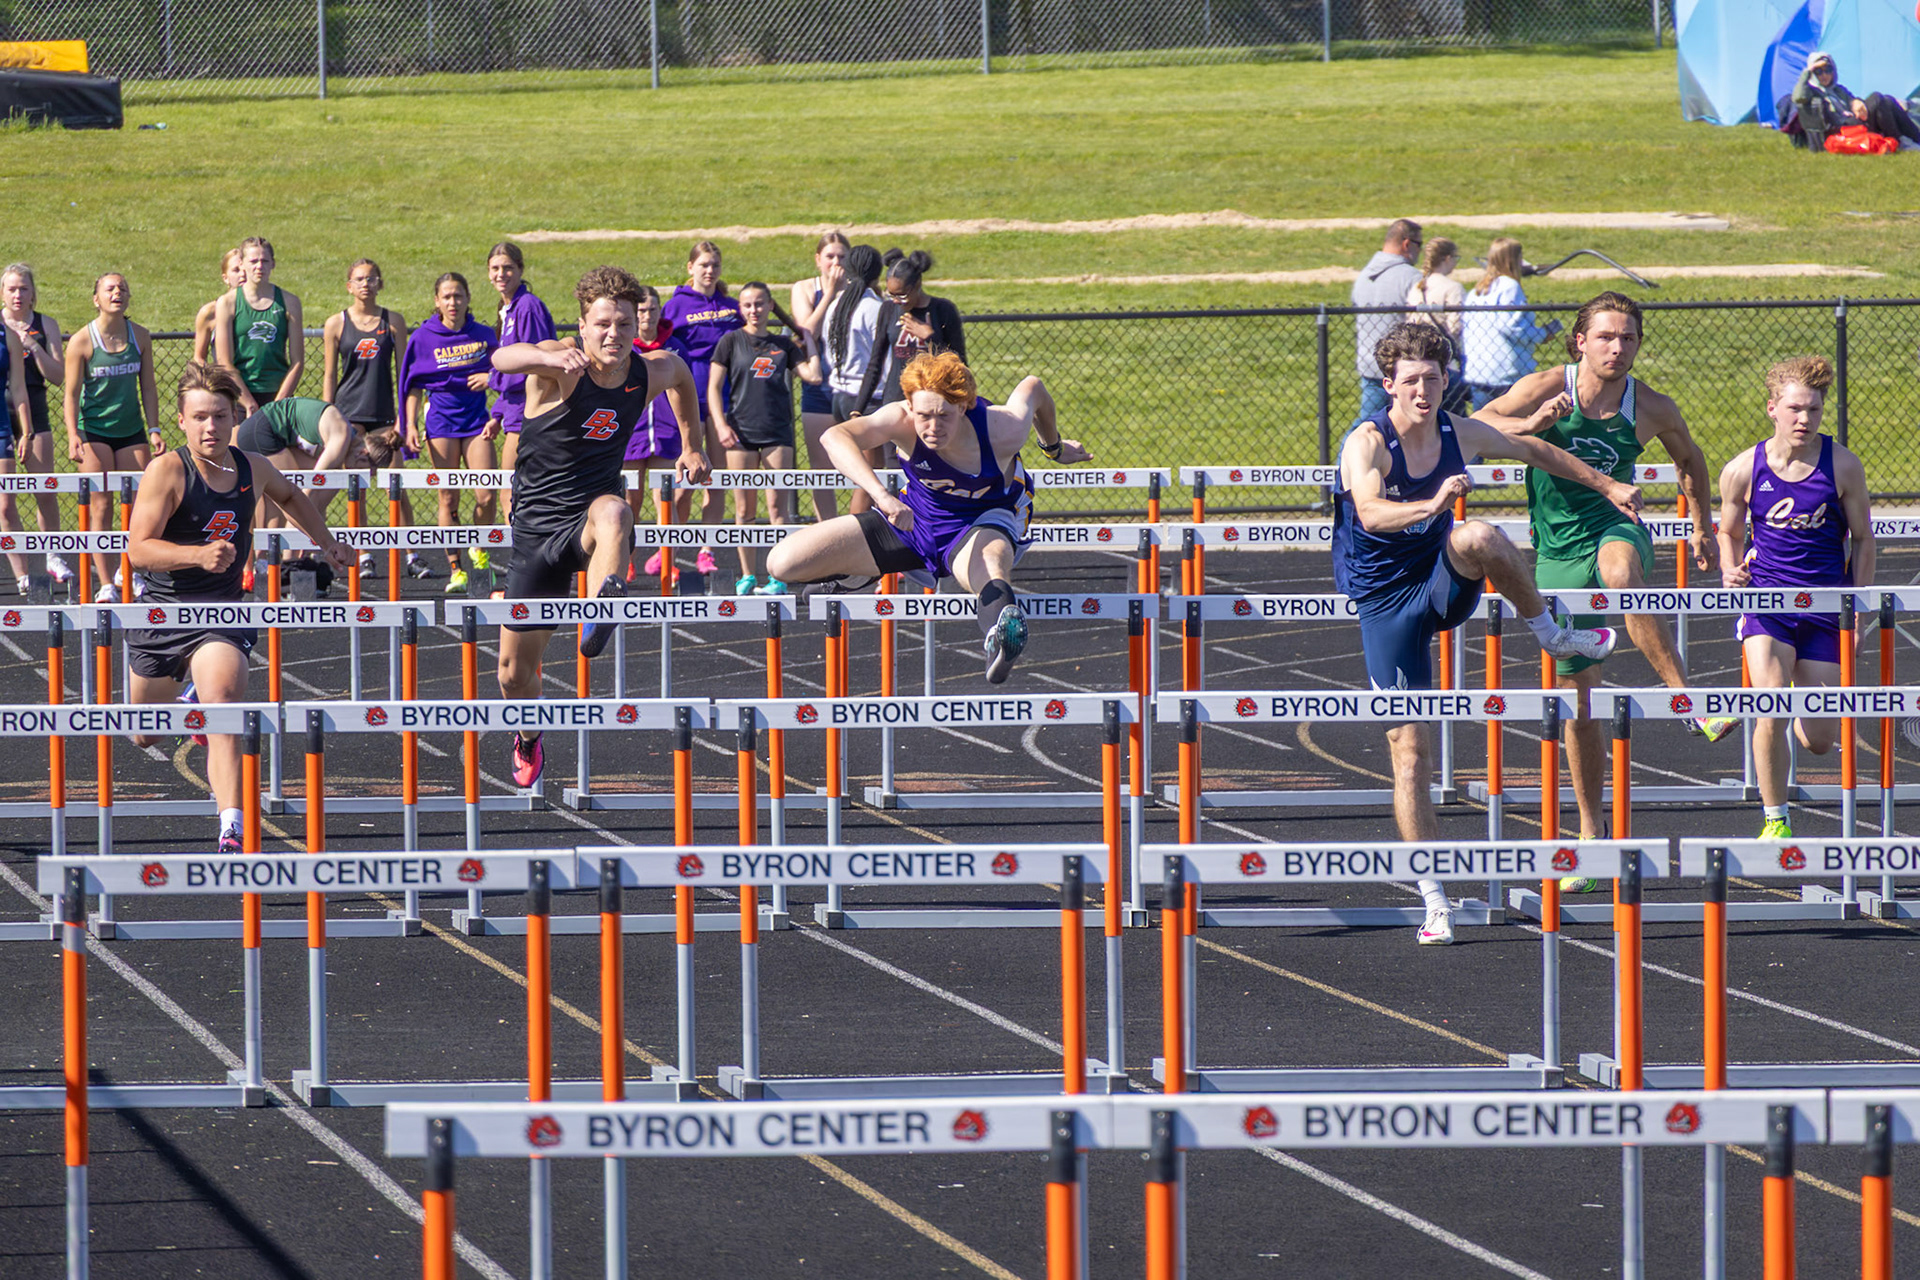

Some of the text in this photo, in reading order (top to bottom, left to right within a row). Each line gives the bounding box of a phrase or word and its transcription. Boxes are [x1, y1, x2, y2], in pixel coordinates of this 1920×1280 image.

[90, 361, 141, 377] JENISON
[581, 408, 620, 441] BC
[447, 474, 502, 486] BYRON
[722, 474, 845, 486] BYRON CENTER
[1043, 472, 1105, 485] CENTER
[1252, 470, 1304, 482] BYRON
[1765, 497, 1827, 530] Cal
[407, 530, 479, 544] CENTER
[645, 529, 787, 543] BYRON CENTER
[1022, 528, 1089, 542] ENTER
[1249, 527, 1309, 541] BYRON
[1645, 522, 1695, 536] NTER
[26, 536, 87, 550] BYRON
[906, 599, 978, 615] BYRON
[1264, 599, 1334, 615] BYRON
[1620, 593, 1784, 609] BYRON CENTER
[179, 607, 346, 624] BYRON CENTER
[541, 601, 707, 619] BYRON CENTER
[1273, 696, 1471, 716] BYRON CENTER
[1707, 692, 1904, 713] BYRON CENTER
[403, 705, 603, 725] BYRON CENTER
[833, 701, 1031, 723] BYRON CENTER
[70, 711, 171, 731] CENTER
[723, 853, 974, 878] BYRON CENTER
[1285, 849, 1534, 875] BYRON CENTER
[187, 859, 441, 886] BYRON CENTER
[1305, 1103, 1642, 1137] BYRON CENTER
[588, 1111, 928, 1148] BYRON CENTER
